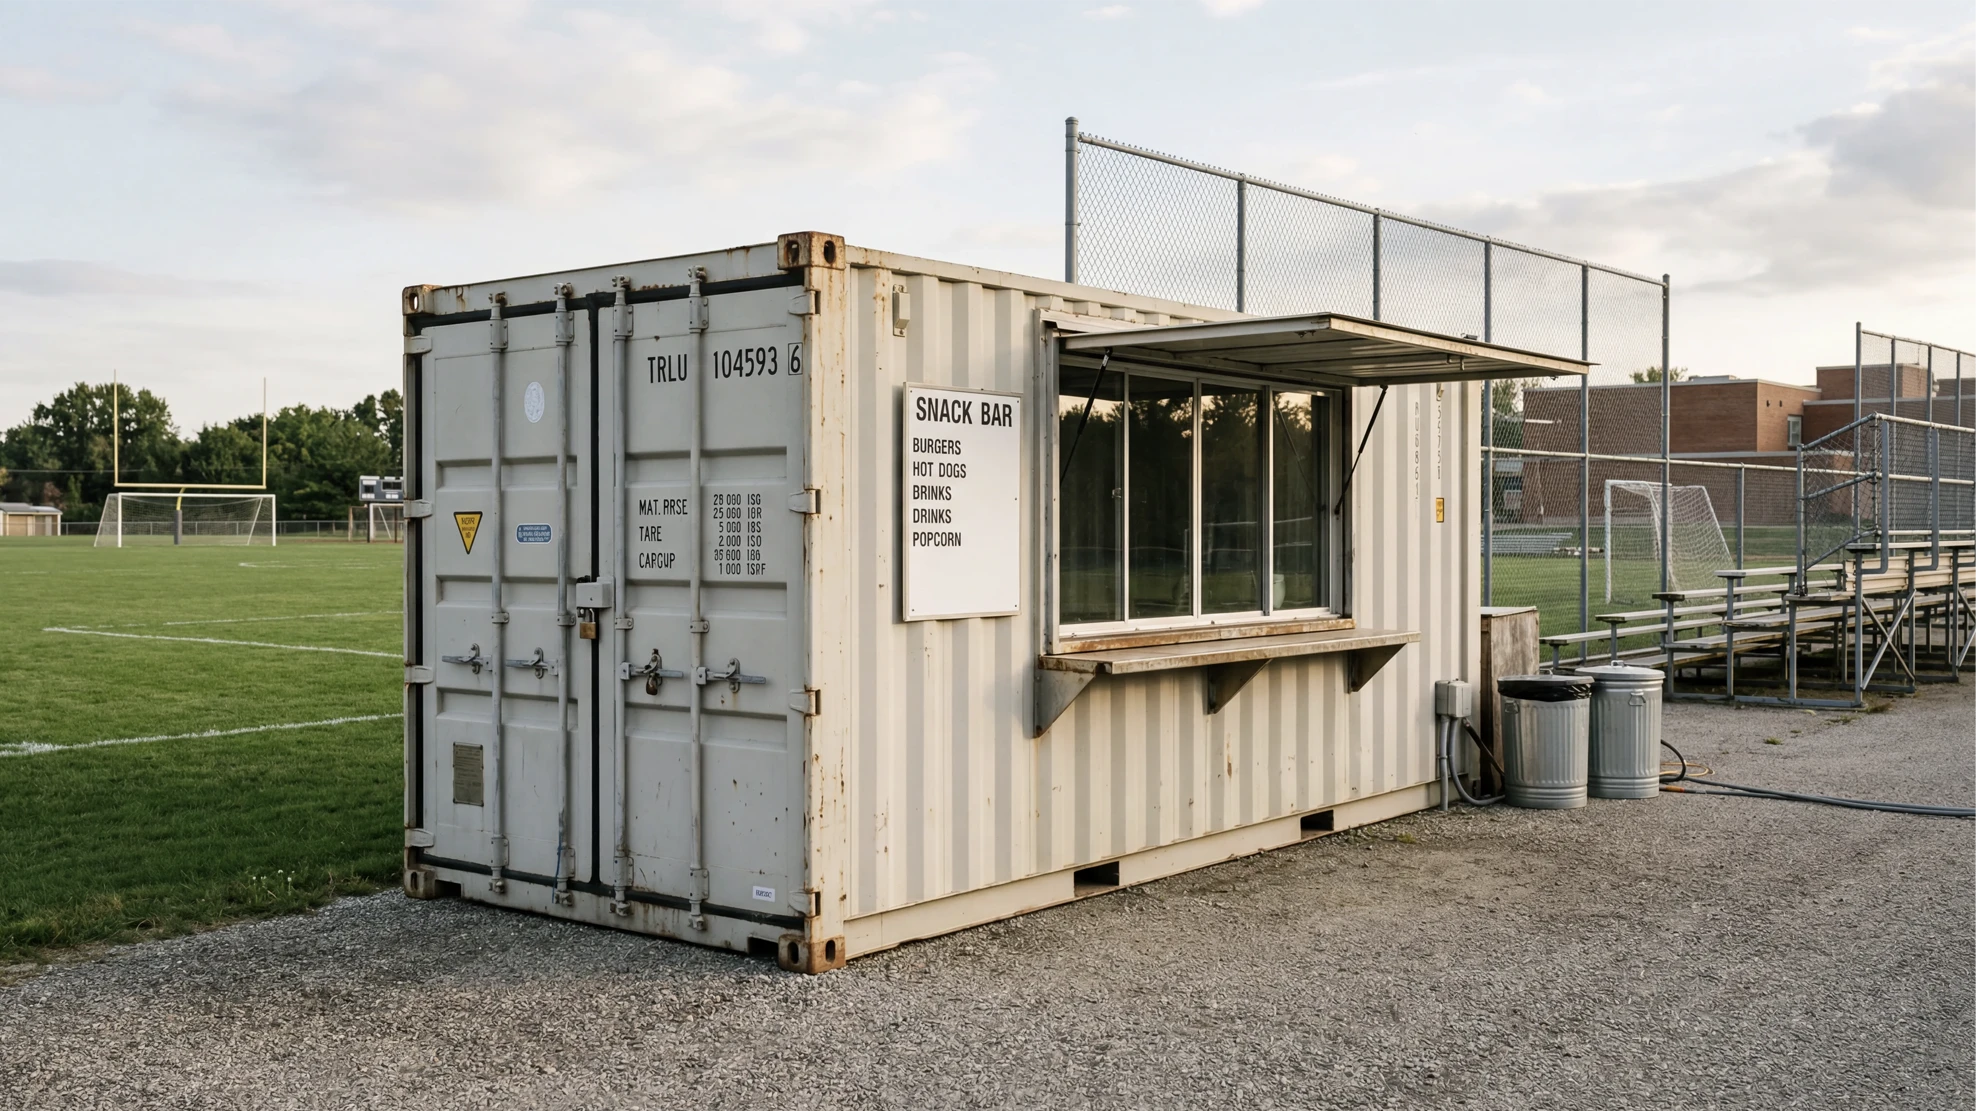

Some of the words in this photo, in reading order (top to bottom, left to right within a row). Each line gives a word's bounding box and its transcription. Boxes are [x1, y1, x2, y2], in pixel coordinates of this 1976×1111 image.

[648, 354, 687, 383] TRLU
[714, 346, 777, 379] 104593
[790, 345, 800, 373] 6
[916, 397, 972, 424] SNACK
[982, 402, 1012, 427] BAR
[913, 438, 961, 455] BURGERS
[913, 461, 933, 476] HOT
[939, 463, 966, 478] DOGS
[913, 485, 951, 500] BRINKS
[640, 500, 660, 516] MAT.
[913, 509, 951, 523] DRINKS
[638, 526, 662, 542] TARE
[718, 534, 724, 546] 2
[913, 532, 961, 546] POPCORN
